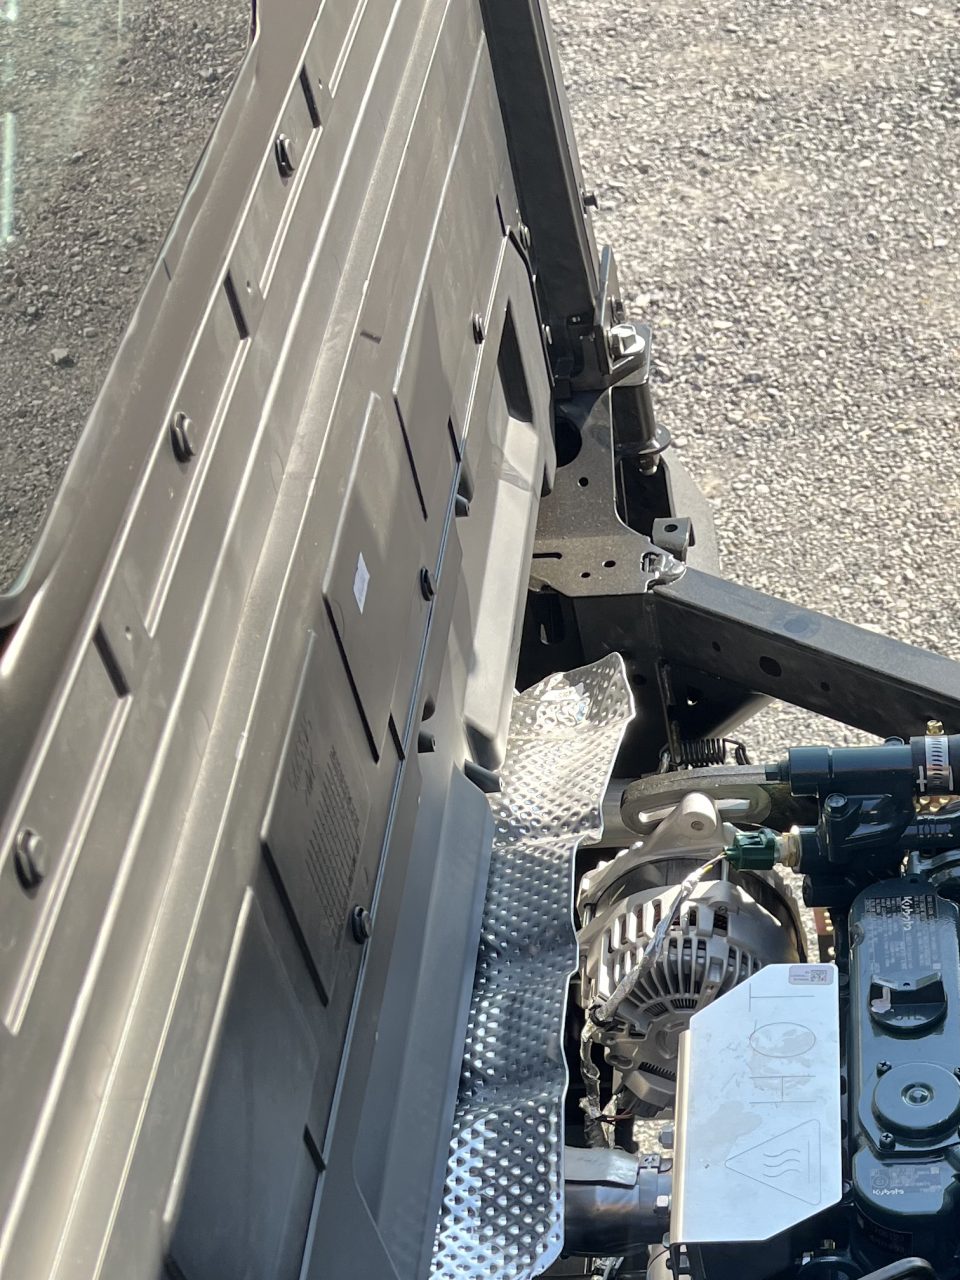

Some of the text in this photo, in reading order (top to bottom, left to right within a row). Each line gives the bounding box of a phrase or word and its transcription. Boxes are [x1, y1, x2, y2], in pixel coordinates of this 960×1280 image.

[901, 896, 914, 931] Kubota
[749, 982, 817, 1104] HOT
[872, 1188, 905, 1197] Kubota
